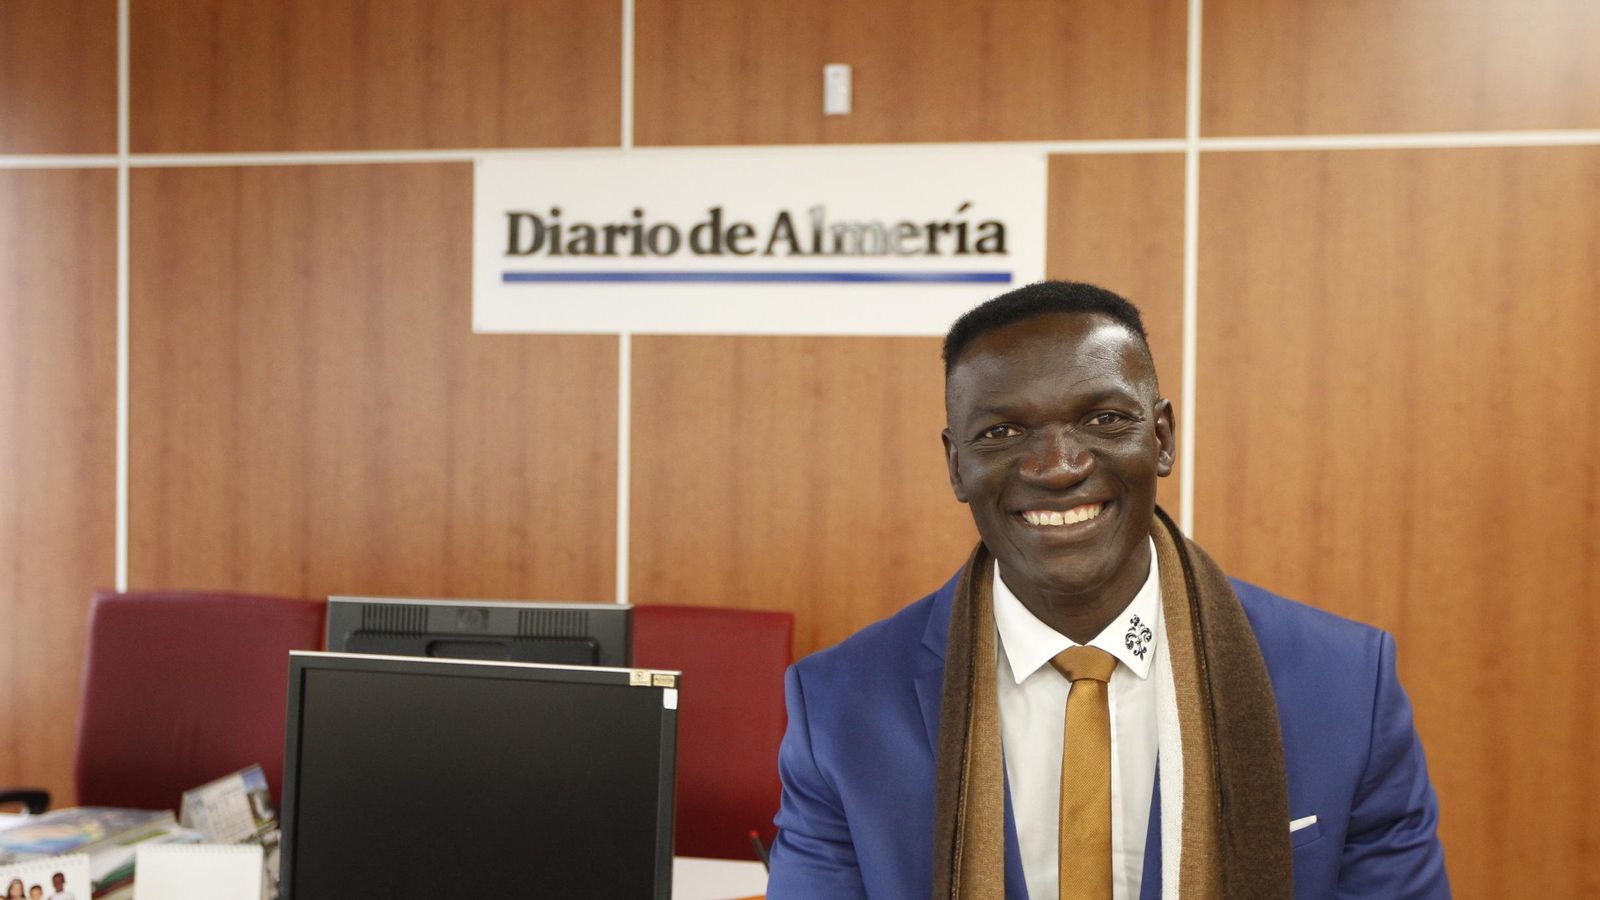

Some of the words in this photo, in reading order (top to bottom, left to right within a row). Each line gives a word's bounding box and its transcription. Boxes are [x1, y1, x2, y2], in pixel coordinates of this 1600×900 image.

[504, 207, 680, 256] Diario
[689, 206, 756, 256] de
[766, 201, 1008, 256] Almería
